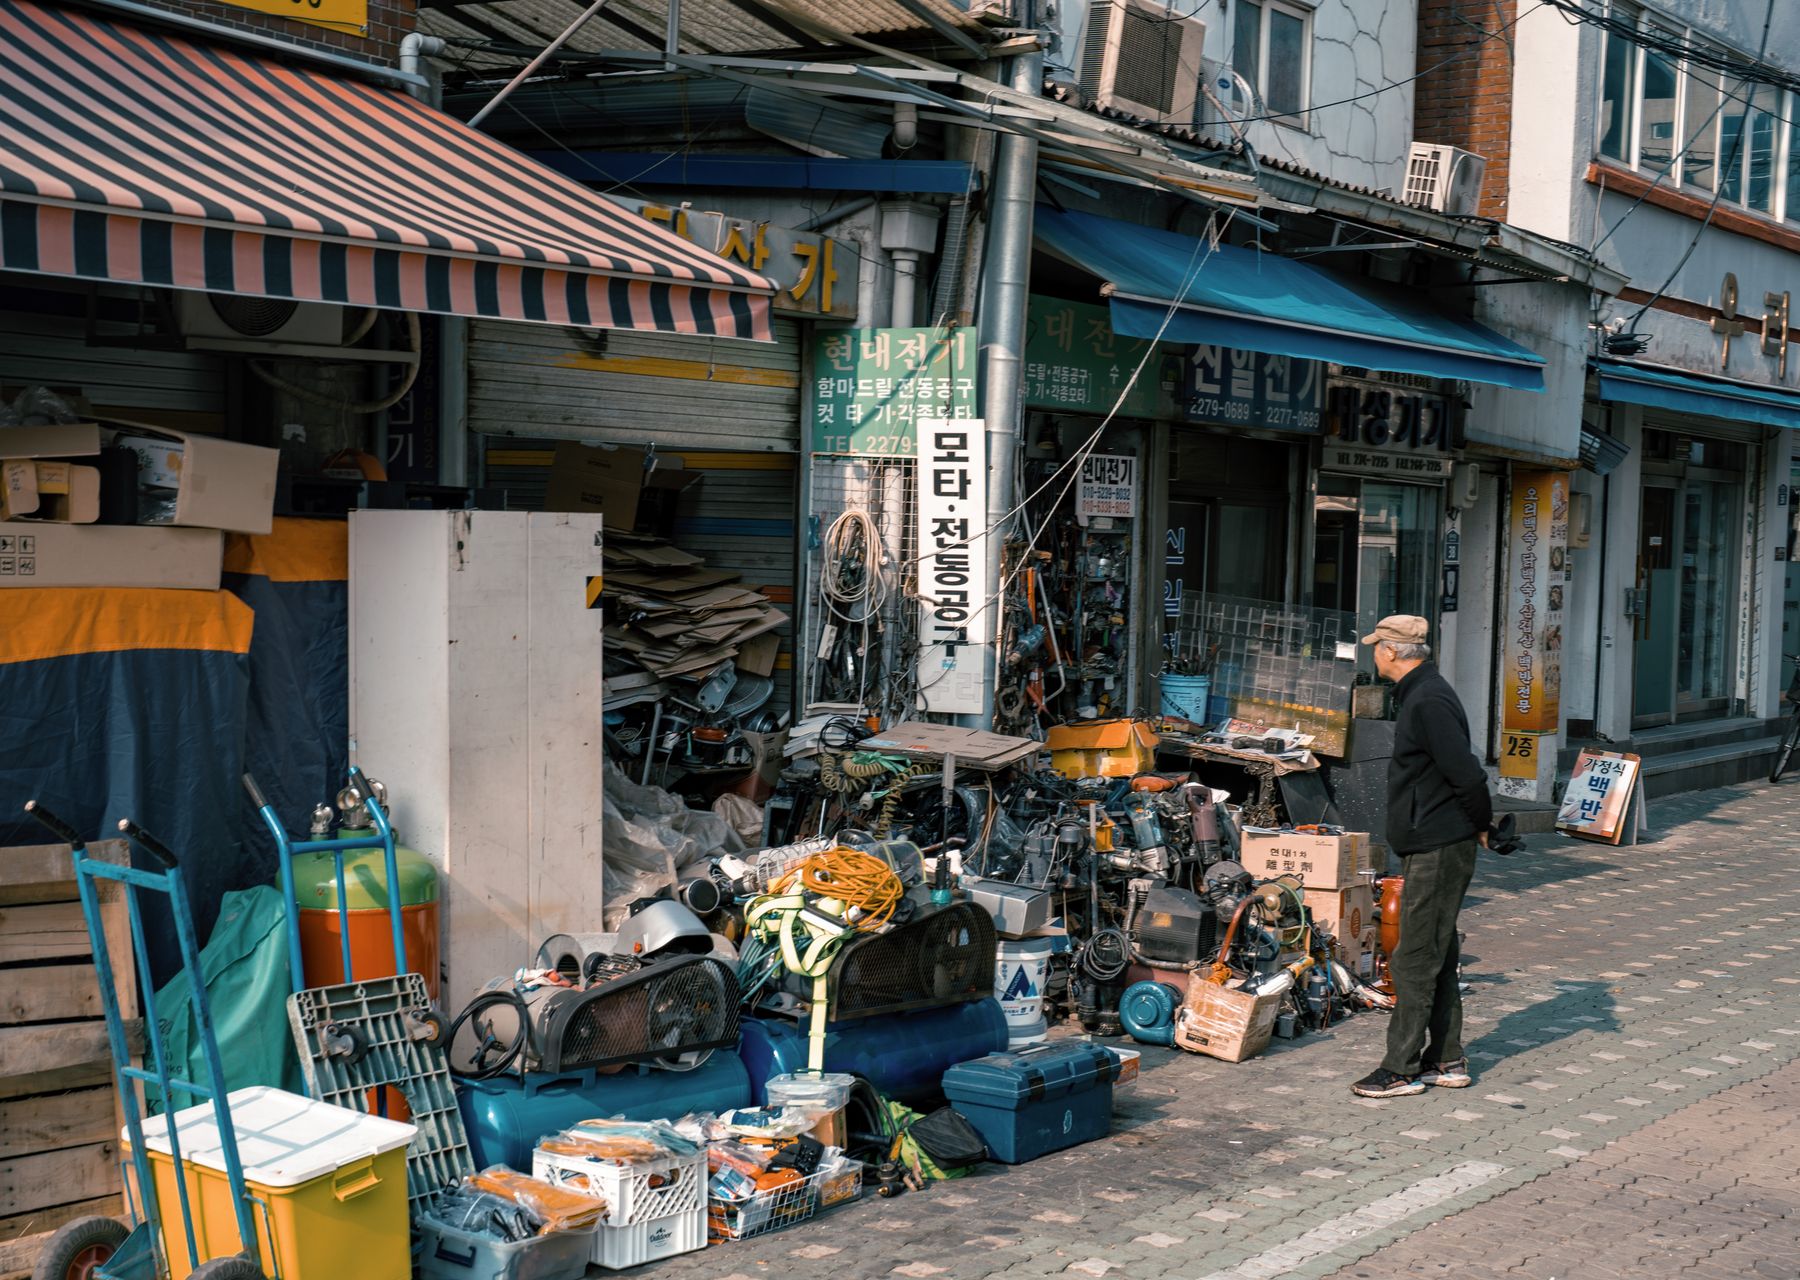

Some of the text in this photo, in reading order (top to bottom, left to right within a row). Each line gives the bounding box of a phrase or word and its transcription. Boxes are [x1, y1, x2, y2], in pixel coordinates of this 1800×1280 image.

[822, 332, 966, 371] 현대전기
[1190, 397, 1250, 420] 2279-0689
[1266, 406, 1321, 428] 2277-0689
[823, 435, 859, 453] TEL
[1507, 735, 1534, 758] 2층
[1583, 757, 1627, 777] 가정식
[649, 1232, 672, 1243] Outdoor
